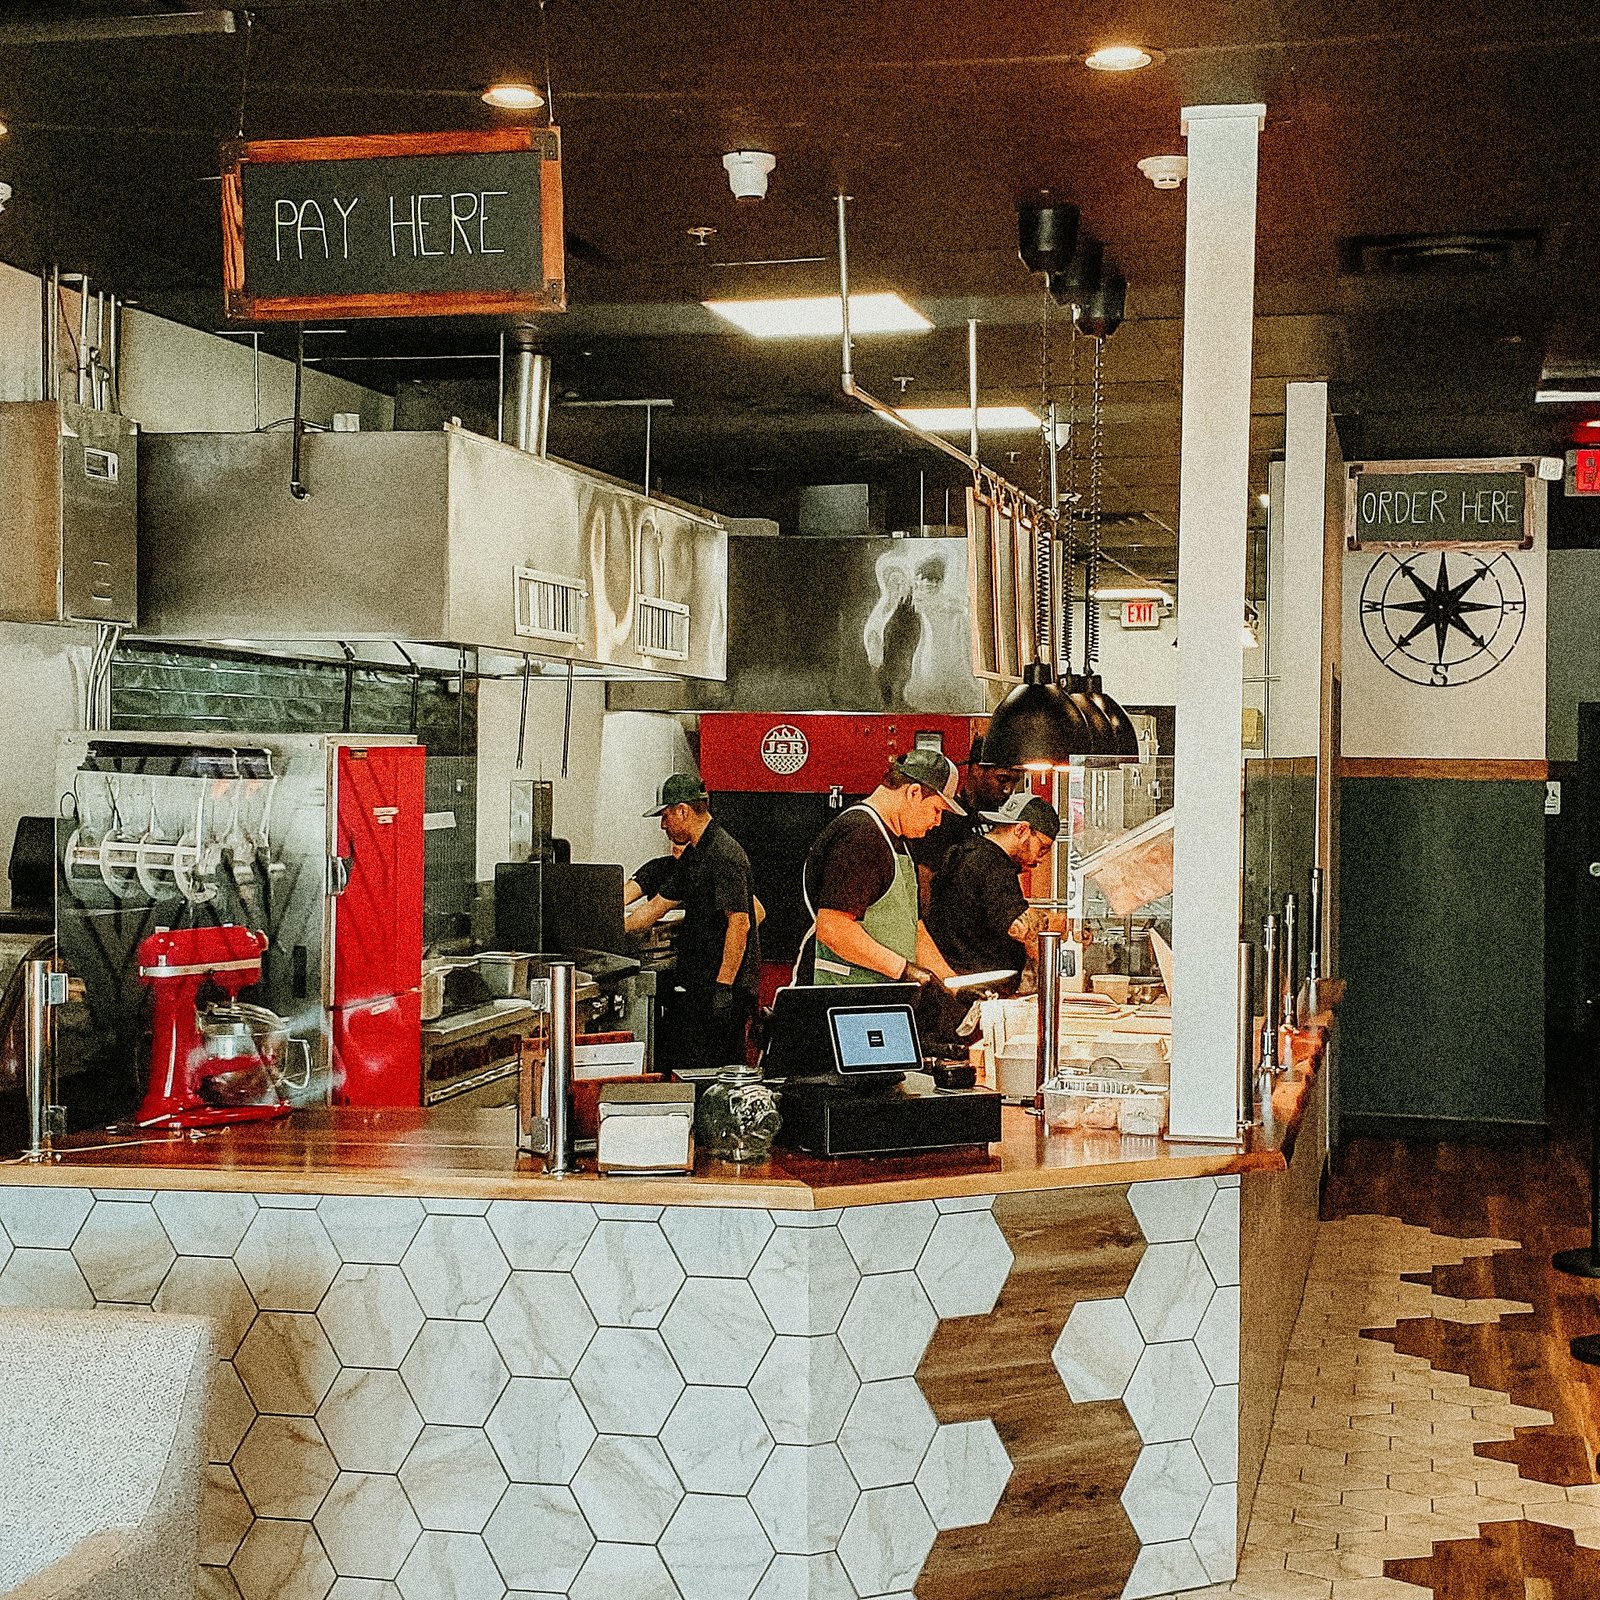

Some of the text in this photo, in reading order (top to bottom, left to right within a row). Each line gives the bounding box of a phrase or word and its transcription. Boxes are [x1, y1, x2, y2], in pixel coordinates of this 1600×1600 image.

[275, 191, 508, 261] PAY HERE
[1362, 490, 1519, 524] ORDER HERE
[1127, 603, 1154, 623] EXIT
[1430, 664, 1449, 686] S
